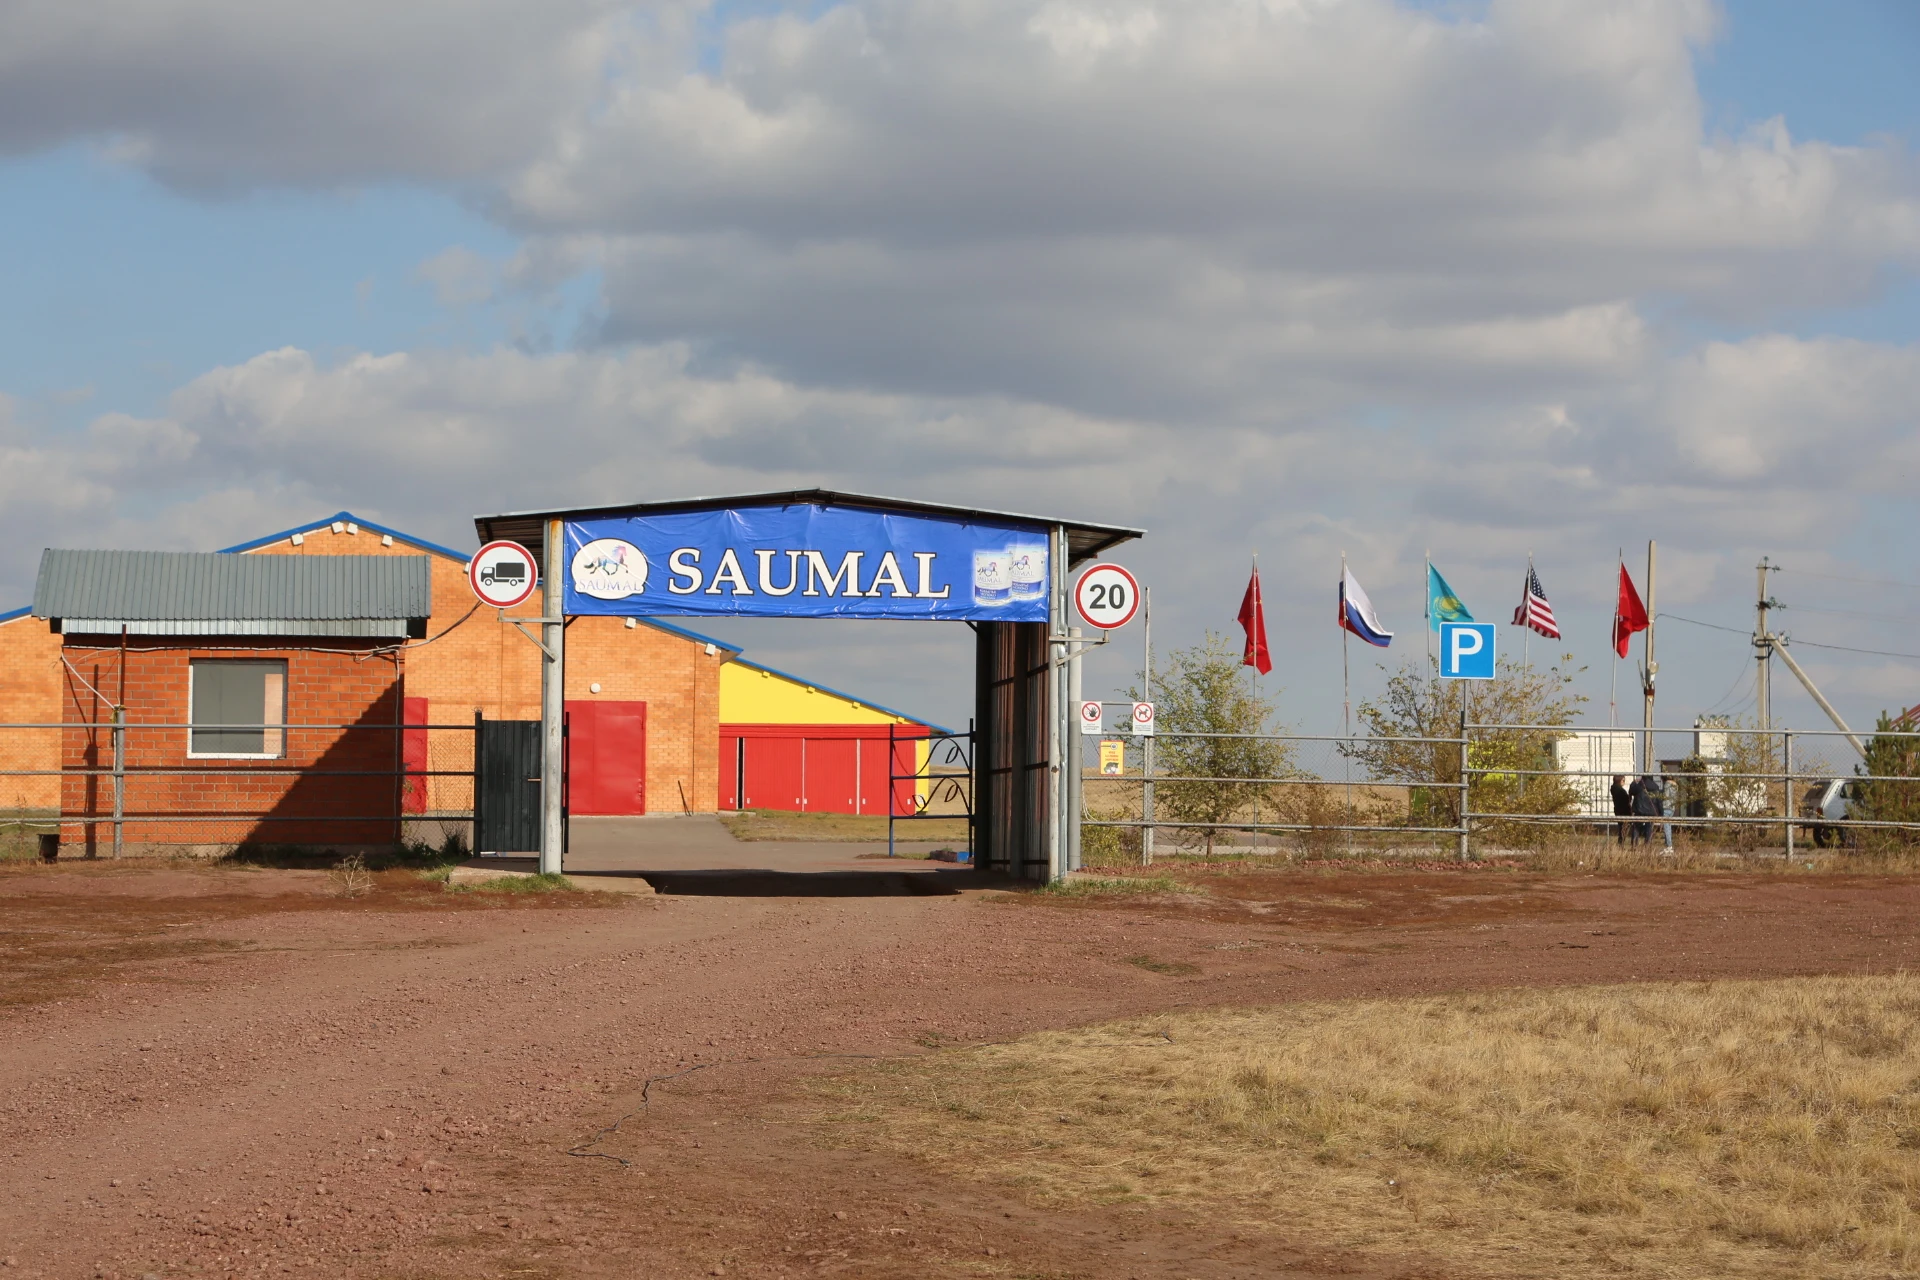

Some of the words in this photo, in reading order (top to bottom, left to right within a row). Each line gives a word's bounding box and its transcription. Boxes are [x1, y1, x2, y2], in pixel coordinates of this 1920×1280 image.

[579, 579, 641, 592] SAUMAL
[667, 547, 950, 599] SAUMAL
[1089, 584, 1125, 609] 20
[1451, 628, 1483, 673] P
